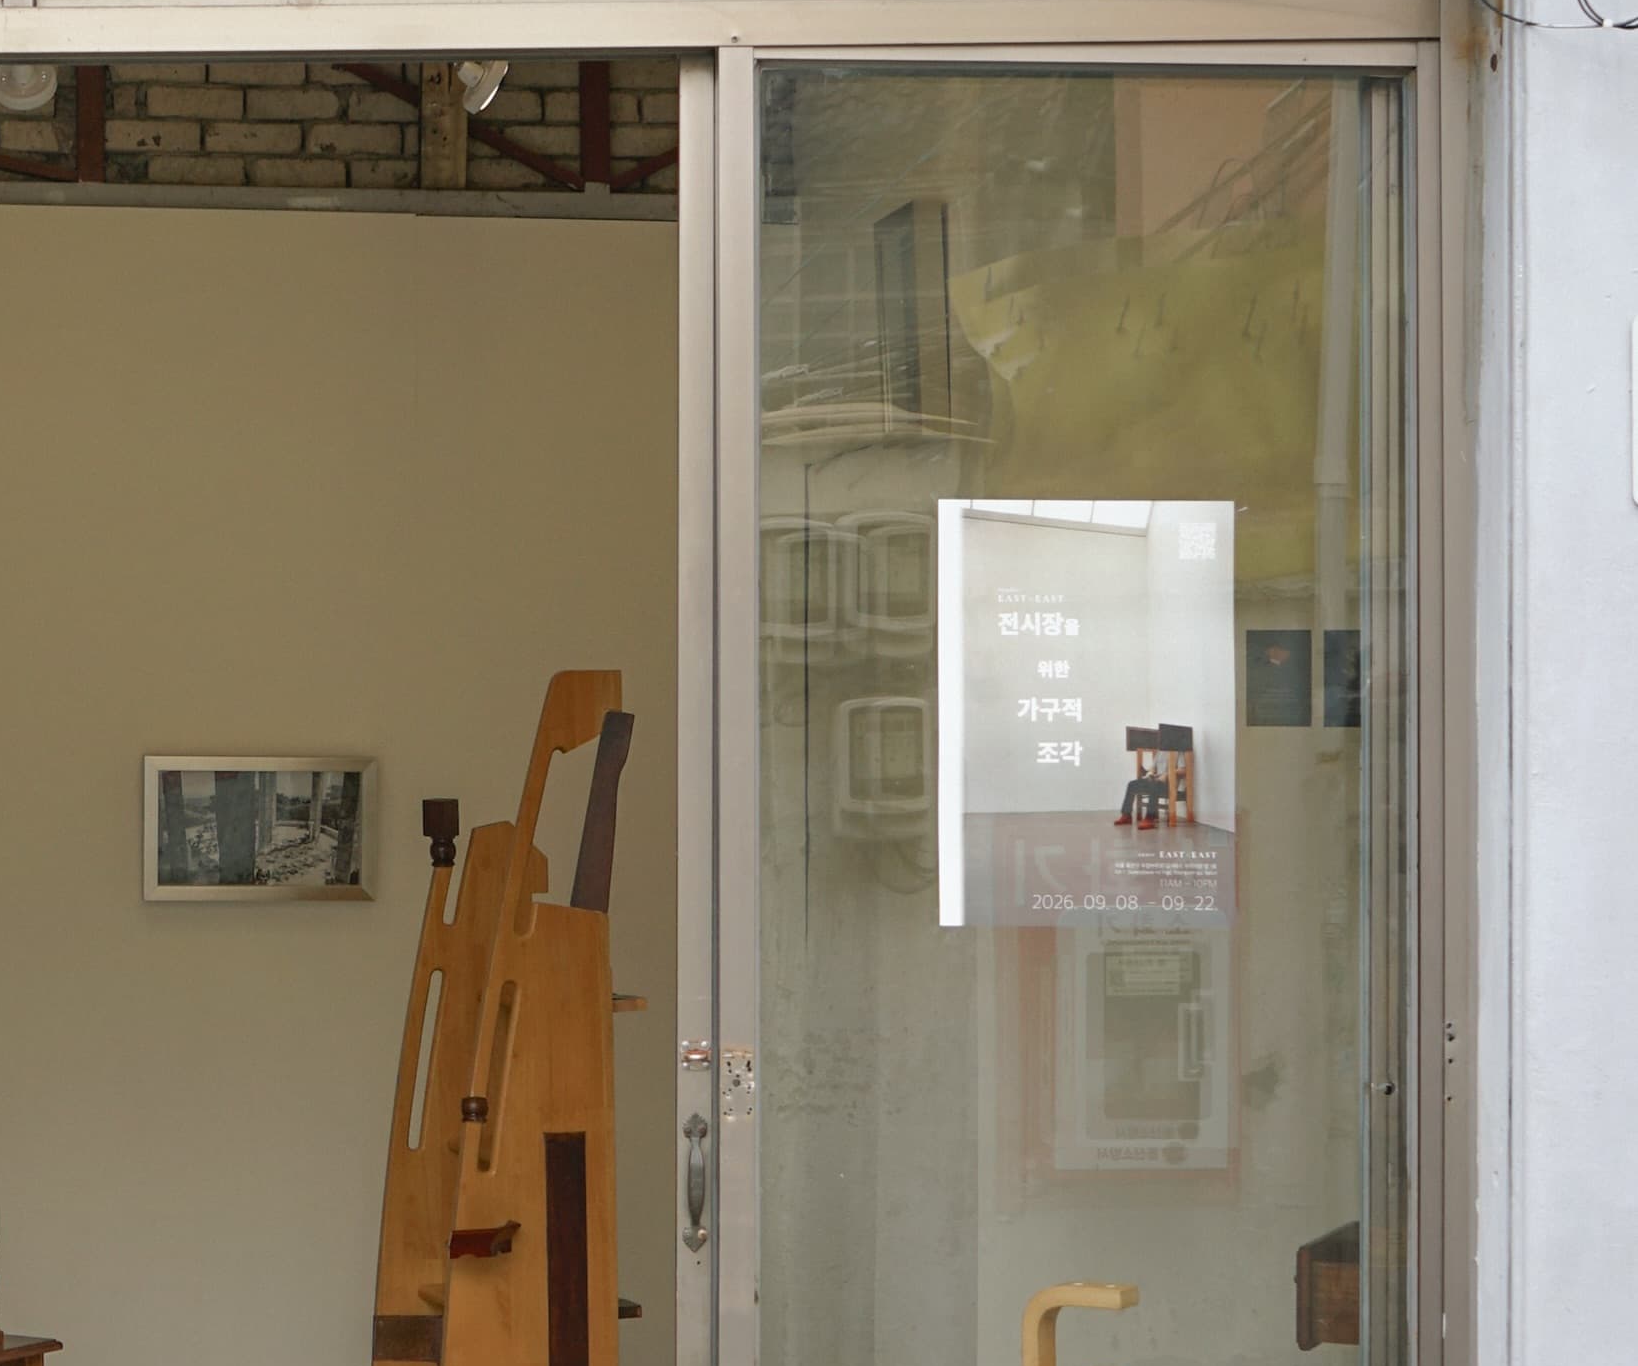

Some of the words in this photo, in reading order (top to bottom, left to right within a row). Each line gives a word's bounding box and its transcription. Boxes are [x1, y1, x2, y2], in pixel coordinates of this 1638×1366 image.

[998, 612, 1080, 637] 전시장을
[1037, 659, 1070, 679] 위한
[1017, 696, 1082, 722] 가구적
[1036, 740, 1083, 766] 조각
[1083, 895, 1109, 910] 09.
[1115, 895, 1141, 910] 08.
[1162, 895, 1188, 911] 09.
